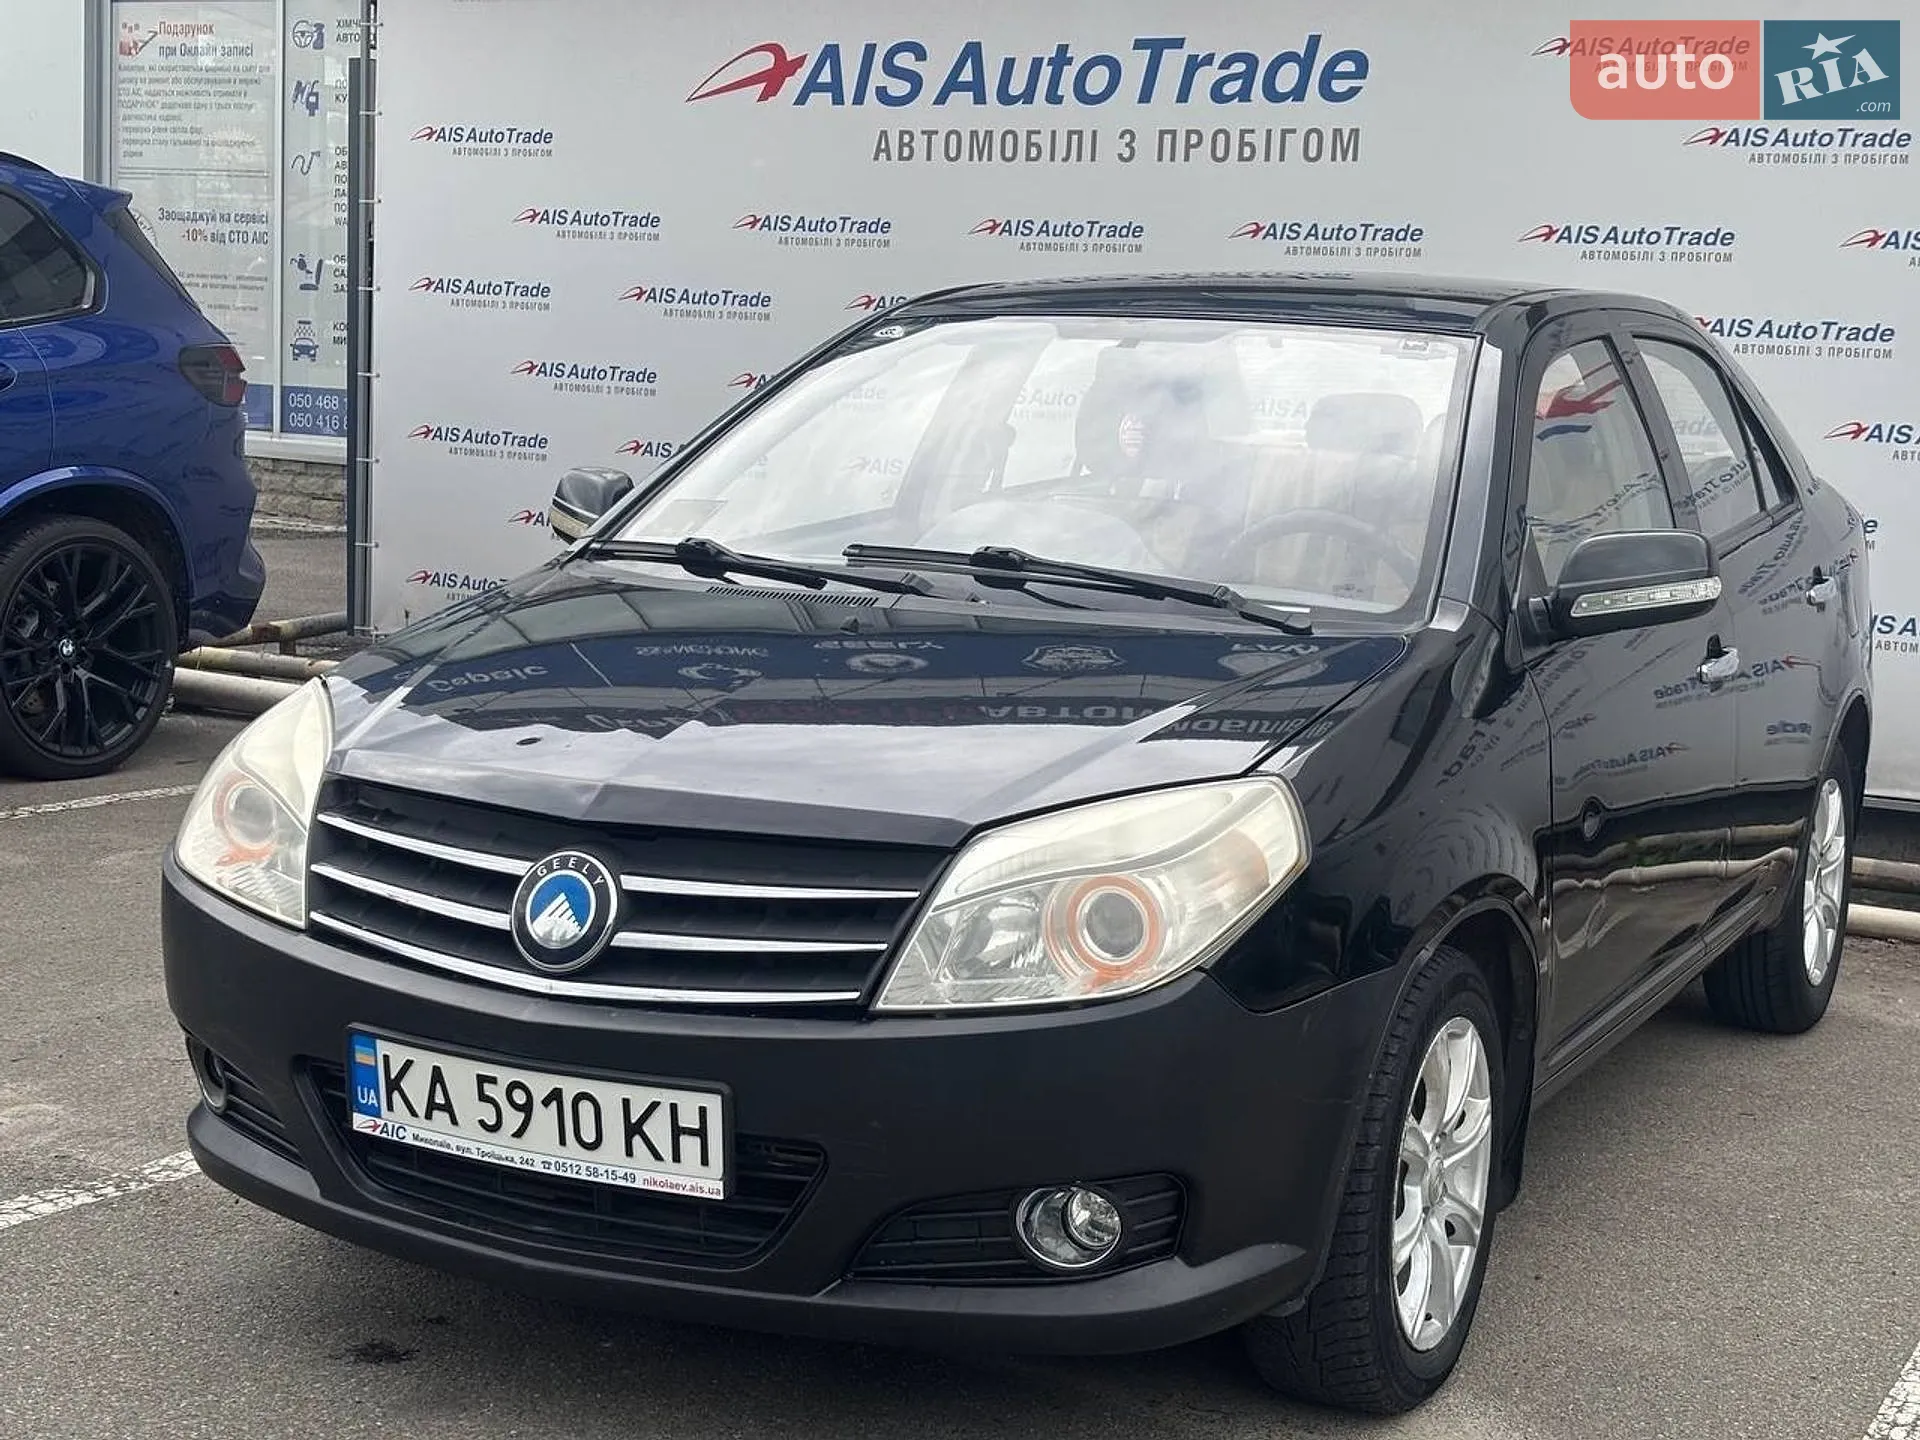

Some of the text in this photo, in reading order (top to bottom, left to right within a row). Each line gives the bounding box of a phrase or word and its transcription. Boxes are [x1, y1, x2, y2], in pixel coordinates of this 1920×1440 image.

[158, 21, 214, 37] Подарунок
[336, 19, 361, 28] ХІМЧ
[159, 43, 253, 59] при Онлайн записі
[794, 41, 924, 106] AIS
[435, 127, 464, 143] AIS
[1722, 128, 1769, 147] AIS
[873, 127, 1361, 163] АВТОМОБІЛІ З ПРОБІГОМ
[158, 208, 269, 225] Заощаджуй на сервісі
[538, 209, 569, 225] AIS
[758, 215, 792, 232] AIS
[182, 228, 269, 245] -10% від СТО АІС
[998, 219, 1034, 237] AIS
[1262, 222, 1301, 240] AIS
[1555, 224, 1599, 245] AIS
[433, 279, 463, 294] AIS
[645, 288, 676, 304] AIS
[1710, 318, 1753, 338] AIS
[536, 362, 566, 378] AIS
[289, 394, 312, 407] 050
[316, 395, 339, 409] 468
[289, 414, 312, 427] 050
[316, 415, 340, 429] 416
[432, 427, 460, 443] AIS
[1864, 423, 1914, 444] AIS
[641, 441, 673, 458] AIS
[429, 572, 458, 588] AIS
[536, 857, 604, 885] GEELY
[356, 1086, 379, 1108] UA
[382, 1054, 710, 1167] KA 5910 KH
[519, 1157, 535, 1168] 242
[554, 1161, 582, 1175] 0512
[586, 1167, 636, 1184] 58-15-49
[643, 1177, 721, 1197] nikolaev.ais.ua
